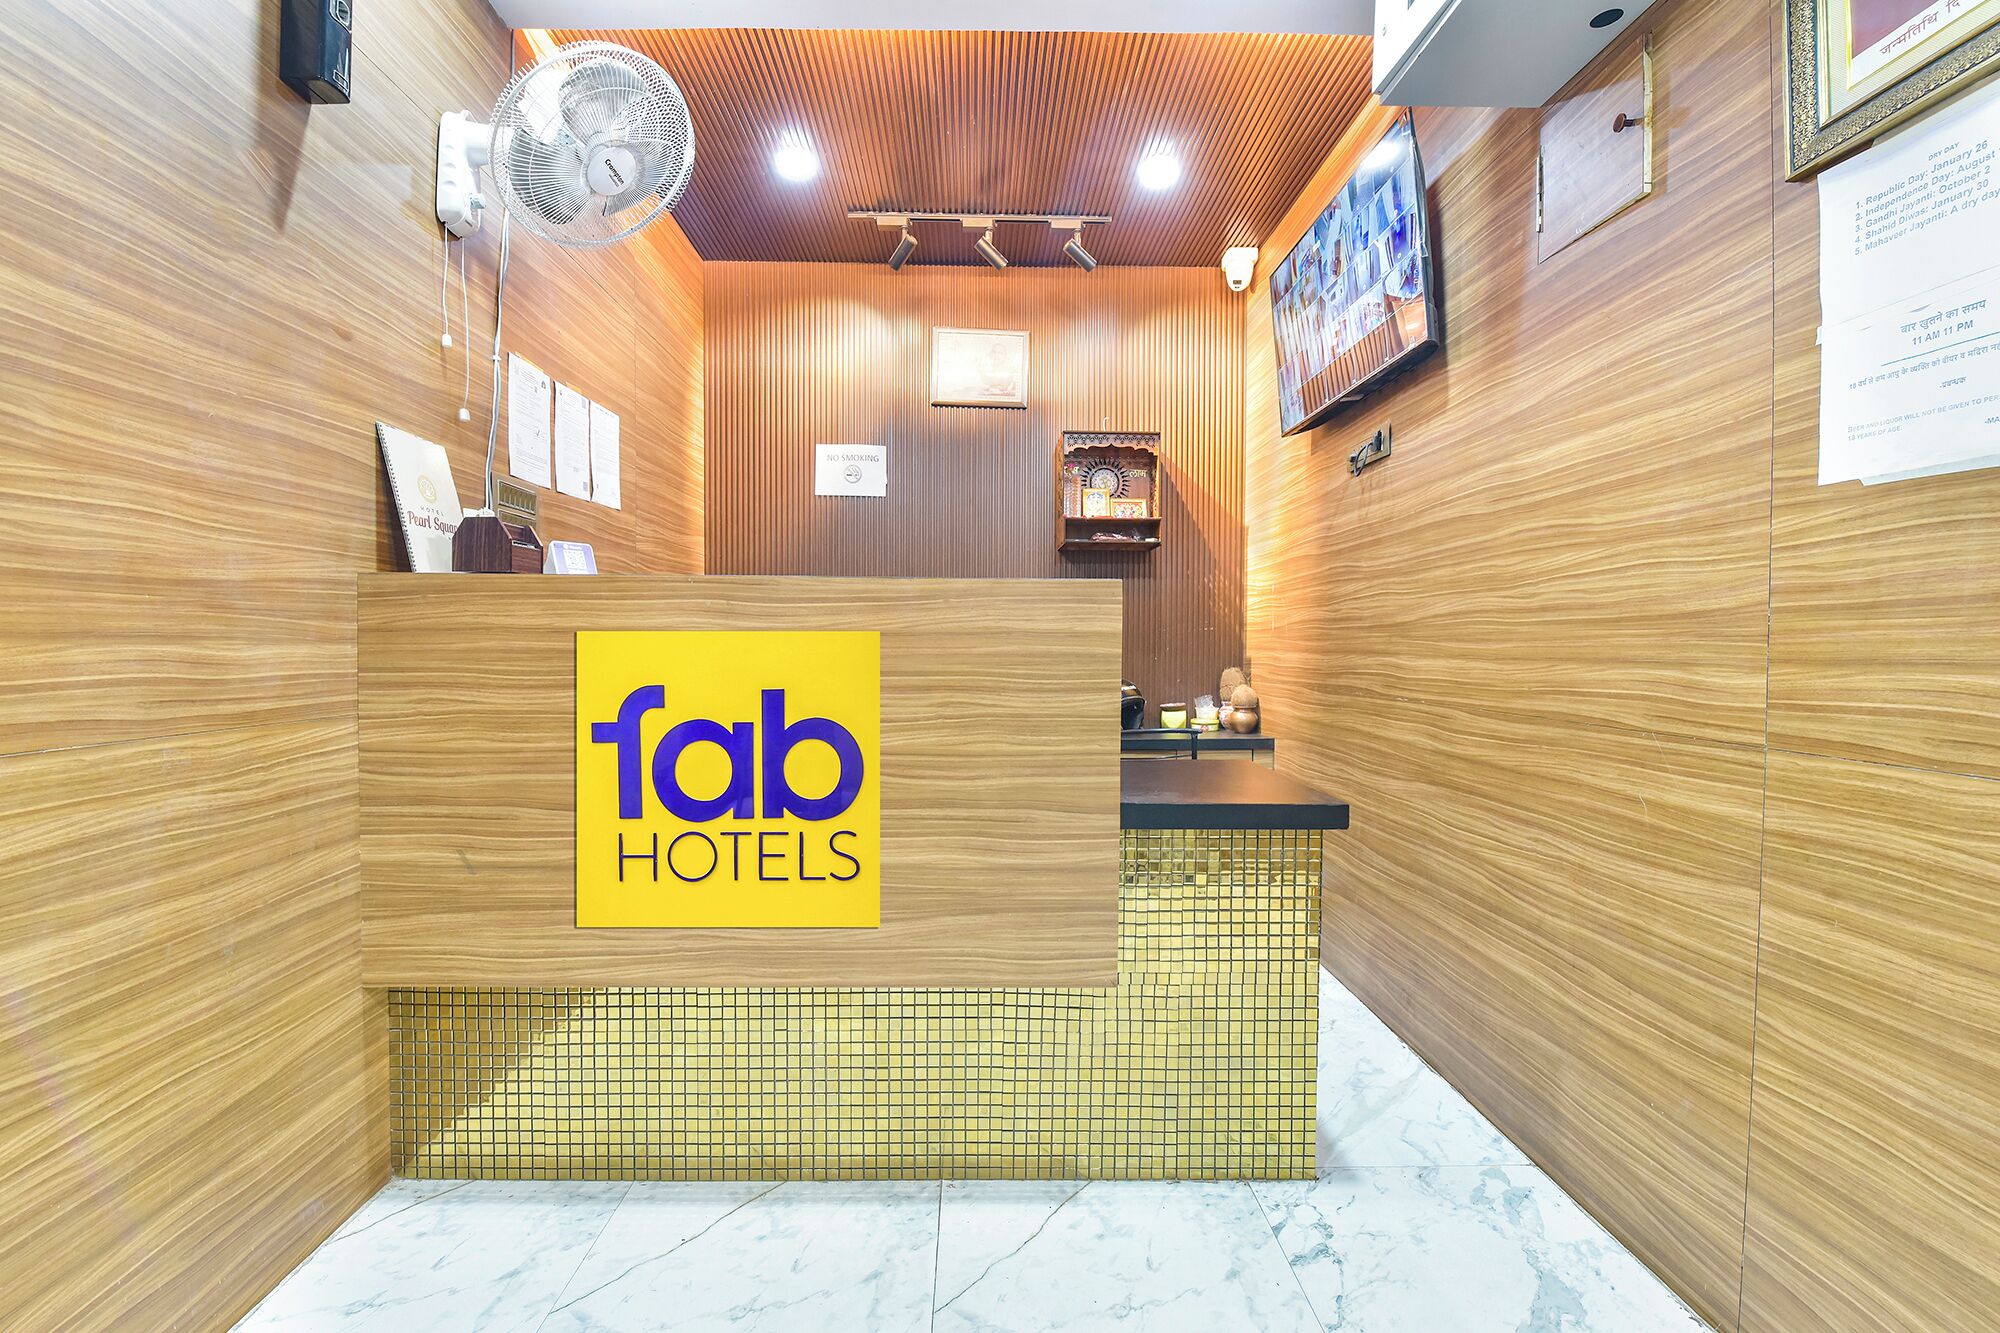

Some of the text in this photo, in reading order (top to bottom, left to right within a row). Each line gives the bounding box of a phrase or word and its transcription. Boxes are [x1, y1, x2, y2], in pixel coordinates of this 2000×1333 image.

[1856, 140, 1988, 209] 1. Republic Day: January 26
[1928, 142, 1960, 161] DRY DAY
[1855, 151, 1995, 222] 2. Independence Day: August
[1855, 165, 1991, 233] 3. Gandhi Jayanti: October 2
[1855, 179, 1989, 244] 4. Shahid Diwas: January 30
[1865, 227, 1908, 251] Mahaveer
[1910, 209, 1947, 232] Jayanti:
[1950, 205, 1959, 214] A
[1961, 197, 1979, 210] dry
[1982, 188, 2000, 201] day
[1912, 319, 1974, 345] 11 AM 11 PM
[1945, 308, 1959, 319] का
[1962, 300, 1987, 314] समय
[1904, 412, 1920, 420] WILL
[1922, 408, 1937, 417] NOT
[1938, 405, 1947, 414] BE
[1948, 401, 1970, 411] GIVEN
[1984, 394, 2000, 403] PER
[827, 454, 879, 463] NO SMOKING
[407, 511, 458, 535] Pearl Squar
[592, 685, 864, 823] fab
[619, 831, 860, 882] HOTELS
